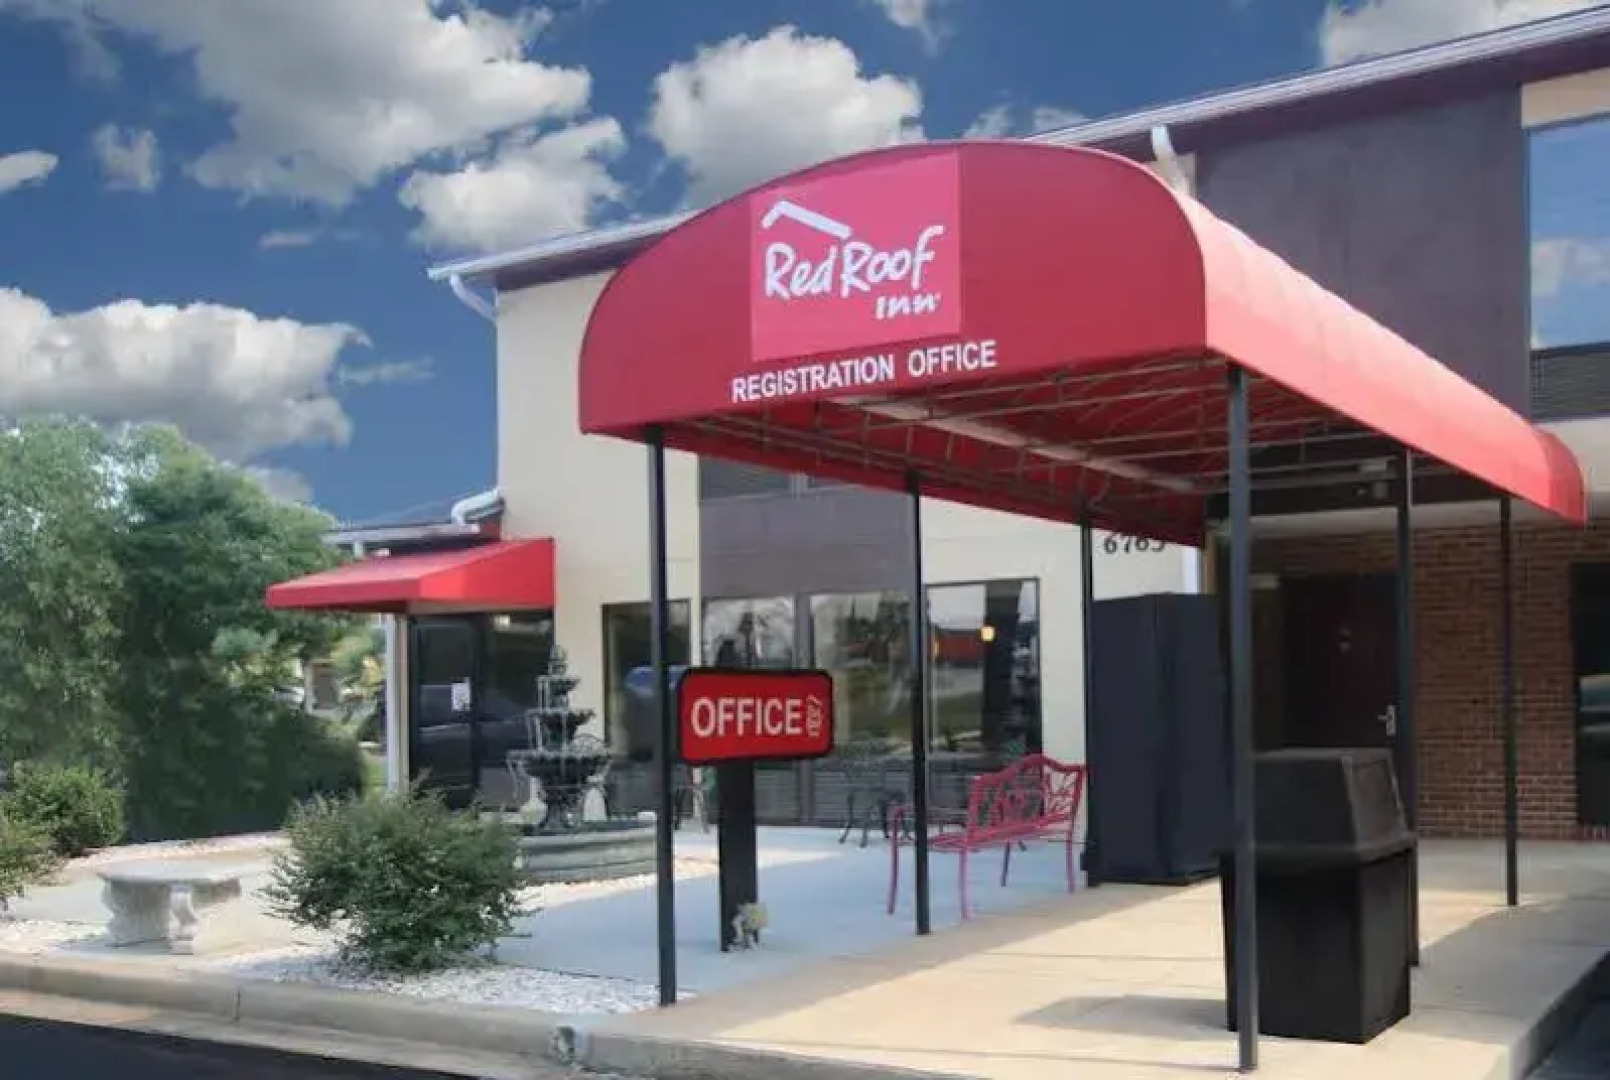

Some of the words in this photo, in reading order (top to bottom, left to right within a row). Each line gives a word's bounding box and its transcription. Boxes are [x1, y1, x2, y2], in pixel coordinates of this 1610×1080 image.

[764, 242, 838, 299] Red
[840, 224, 946, 298] Roof
[731, 354, 895, 403] REGISTRATION
[907, 339, 998, 377] OFFICE
[690, 696, 803, 738] OFFICE
